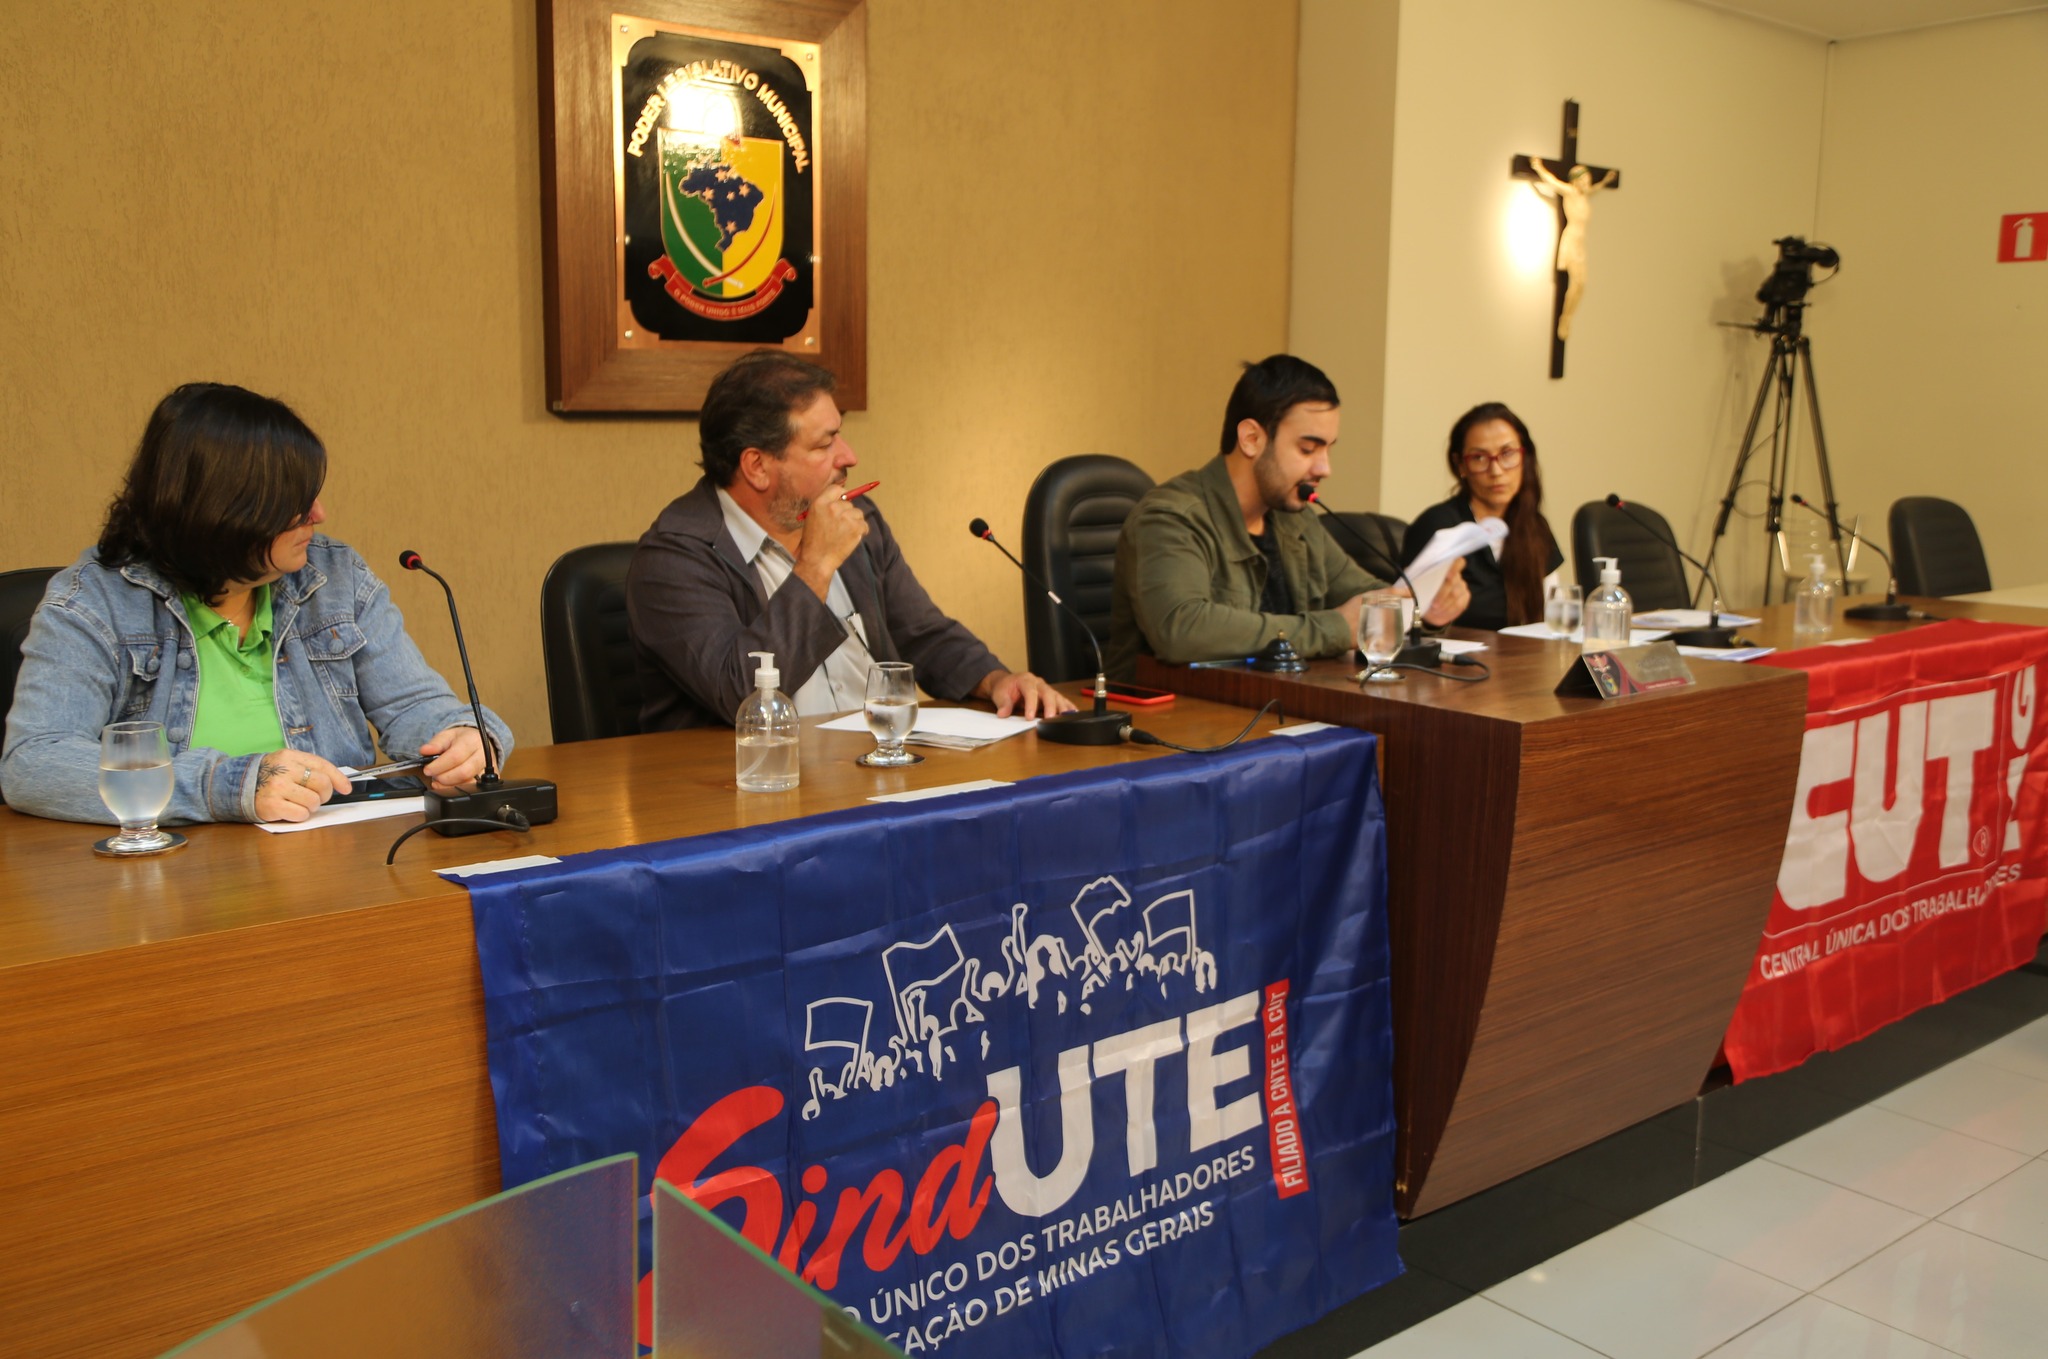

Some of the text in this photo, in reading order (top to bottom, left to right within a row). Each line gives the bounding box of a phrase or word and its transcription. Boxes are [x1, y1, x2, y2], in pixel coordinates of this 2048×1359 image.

[627, 94, 666, 158] PODER
[756, 83, 810, 174] MUNICIPAL
[1777, 688, 1997, 911] CUT
[1760, 940, 1820, 979] CENTRAL
[1825, 920, 1876, 955] ÚNICA
[1879, 906, 1911, 936] DOS
[1268, 992, 1287, 1022] CUT
[1270, 1054, 1289, 1101] CNTE
[1271, 1038, 1285, 1054] E
[1270, 1102, 1291, 1117] À
[1275, 1119, 1304, 1188] FILIADO
[870, 1145, 1256, 1324] ÚNICO DOS TRABALHADORES
[994, 1276, 1033, 1316] DE
[1038, 1239, 1121, 1297] MINAS
[1125, 1201, 1215, 1256] GERAIS
